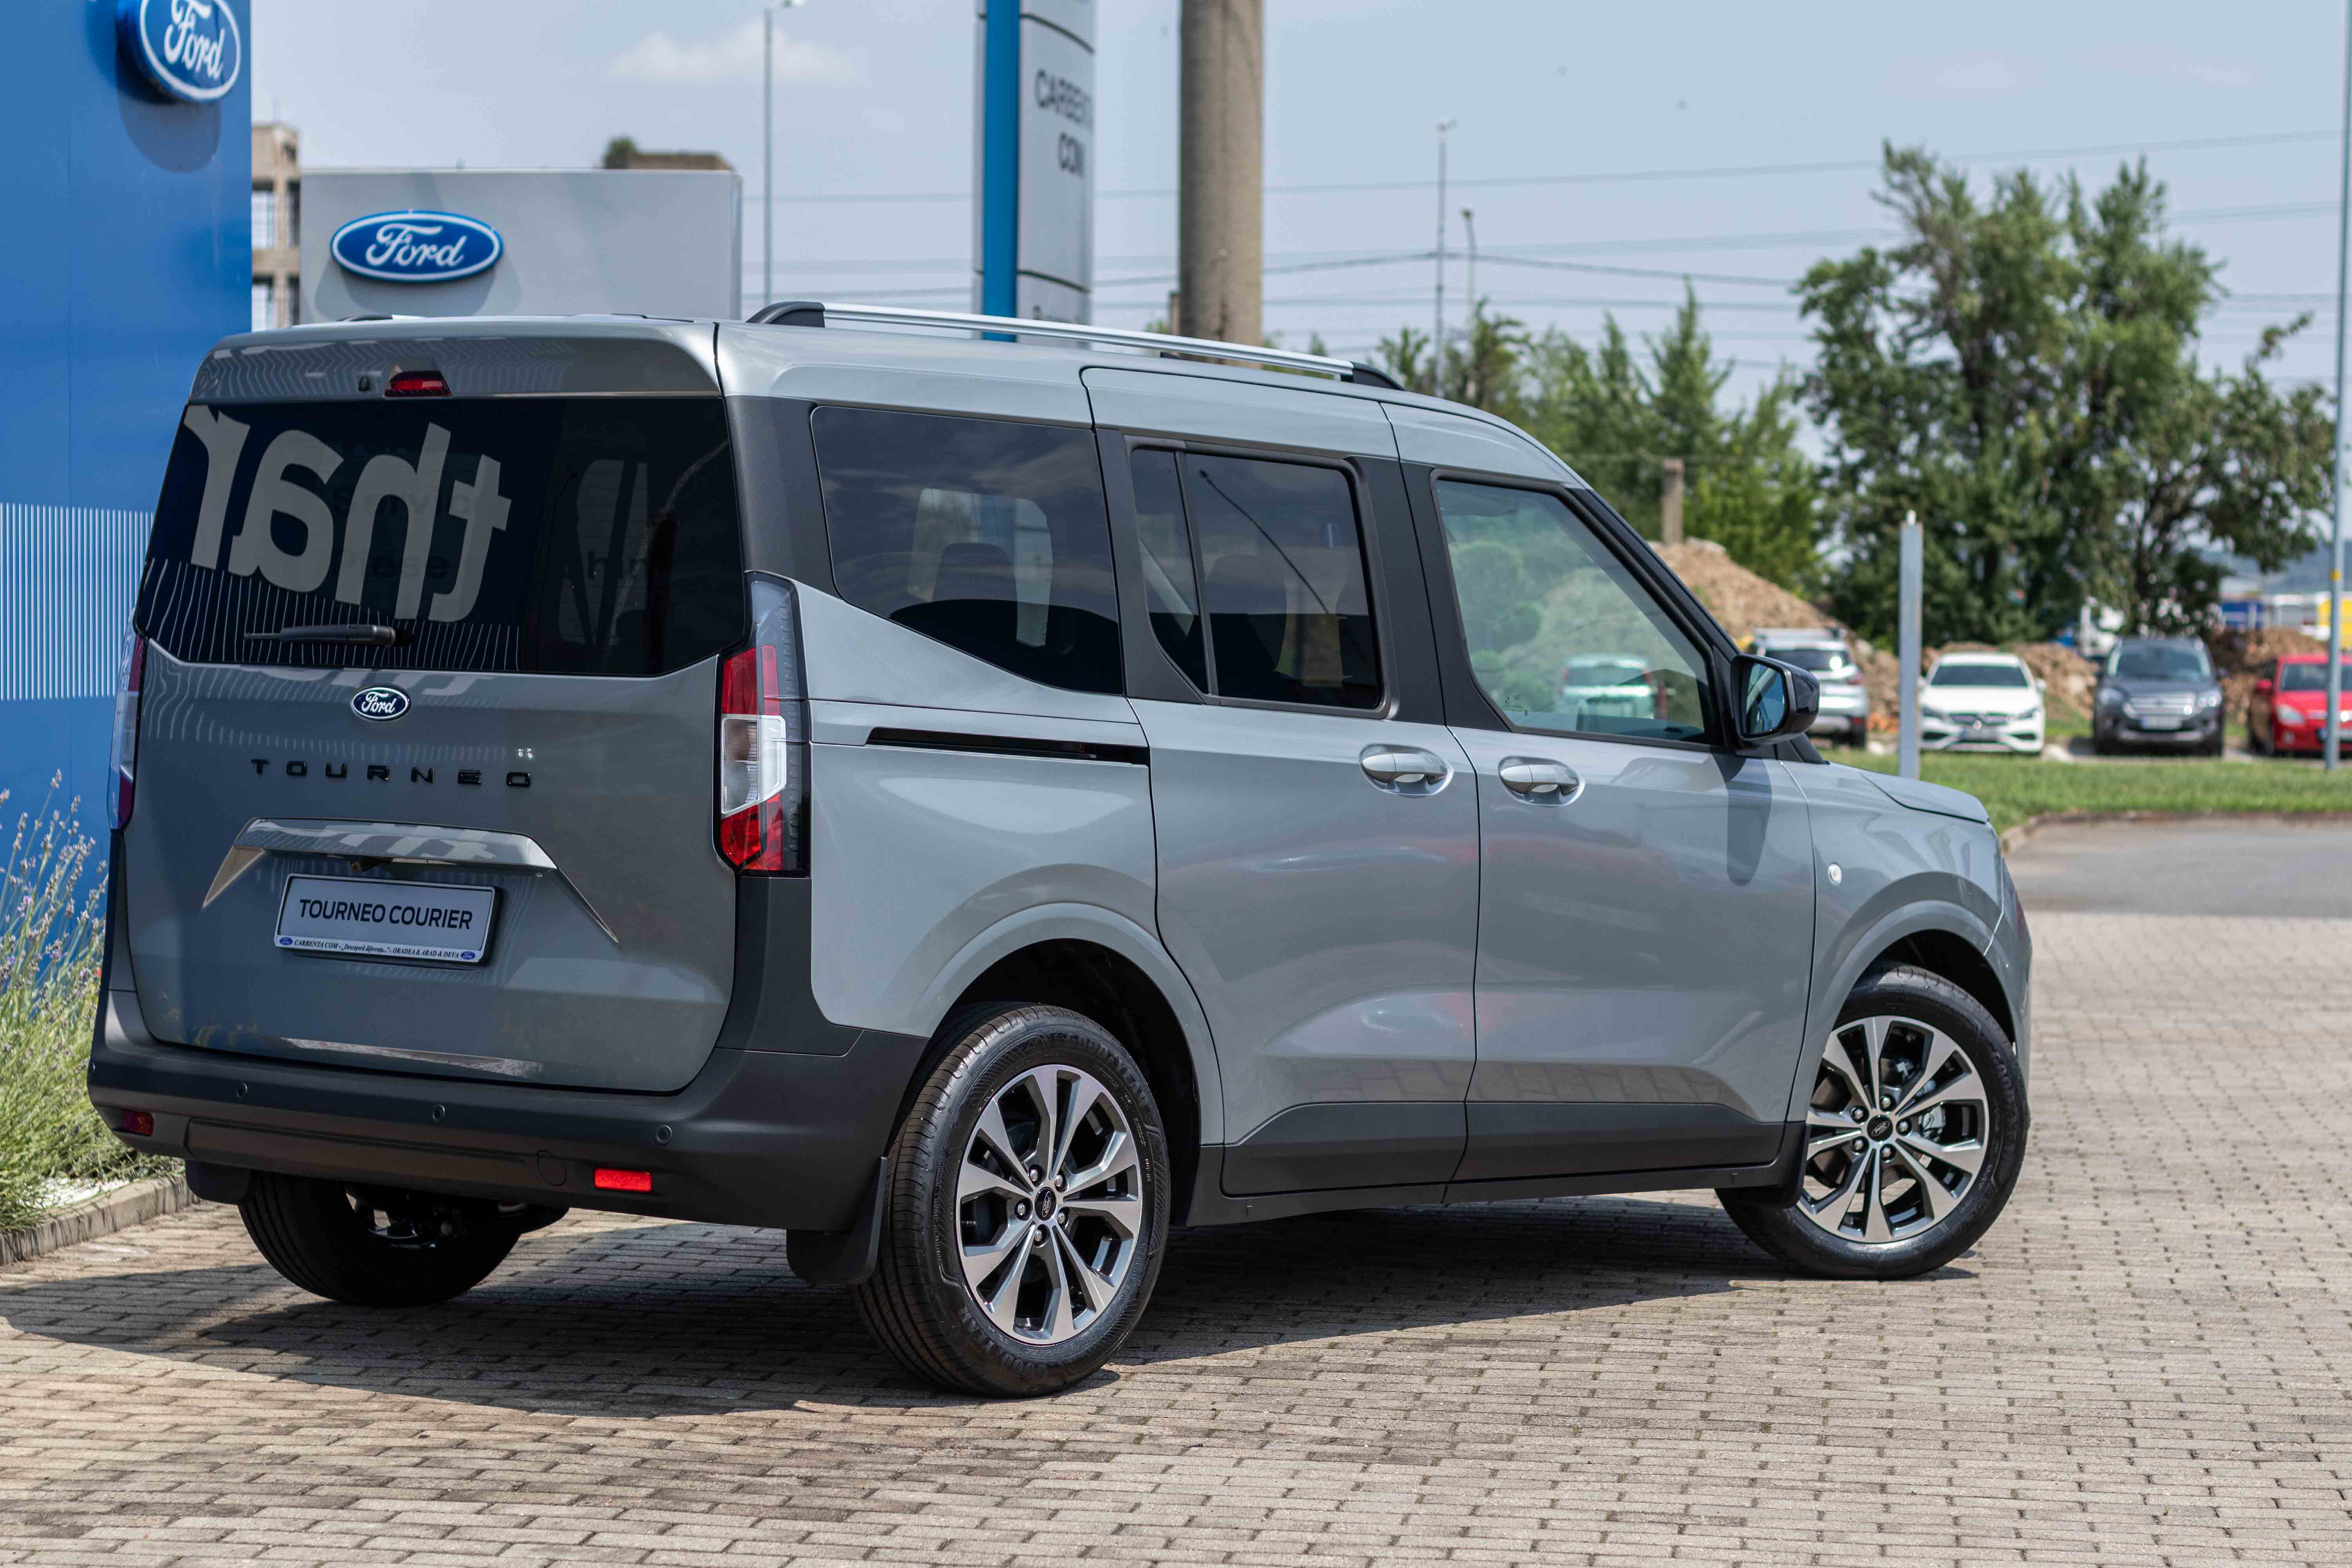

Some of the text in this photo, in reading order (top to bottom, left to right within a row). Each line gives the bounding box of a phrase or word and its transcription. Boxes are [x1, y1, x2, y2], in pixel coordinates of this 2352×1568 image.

[163, 0, 225, 79] Ford
[365, 223, 467, 267] Ford
[361, 691, 397, 713] Ford
[251, 759, 532, 788] TOURNEO
[299, 898, 473, 930] TOURNEO COURIER
[294, 940, 323, 948] CARBENTA
[393, 947, 415, 955] ORADEA
